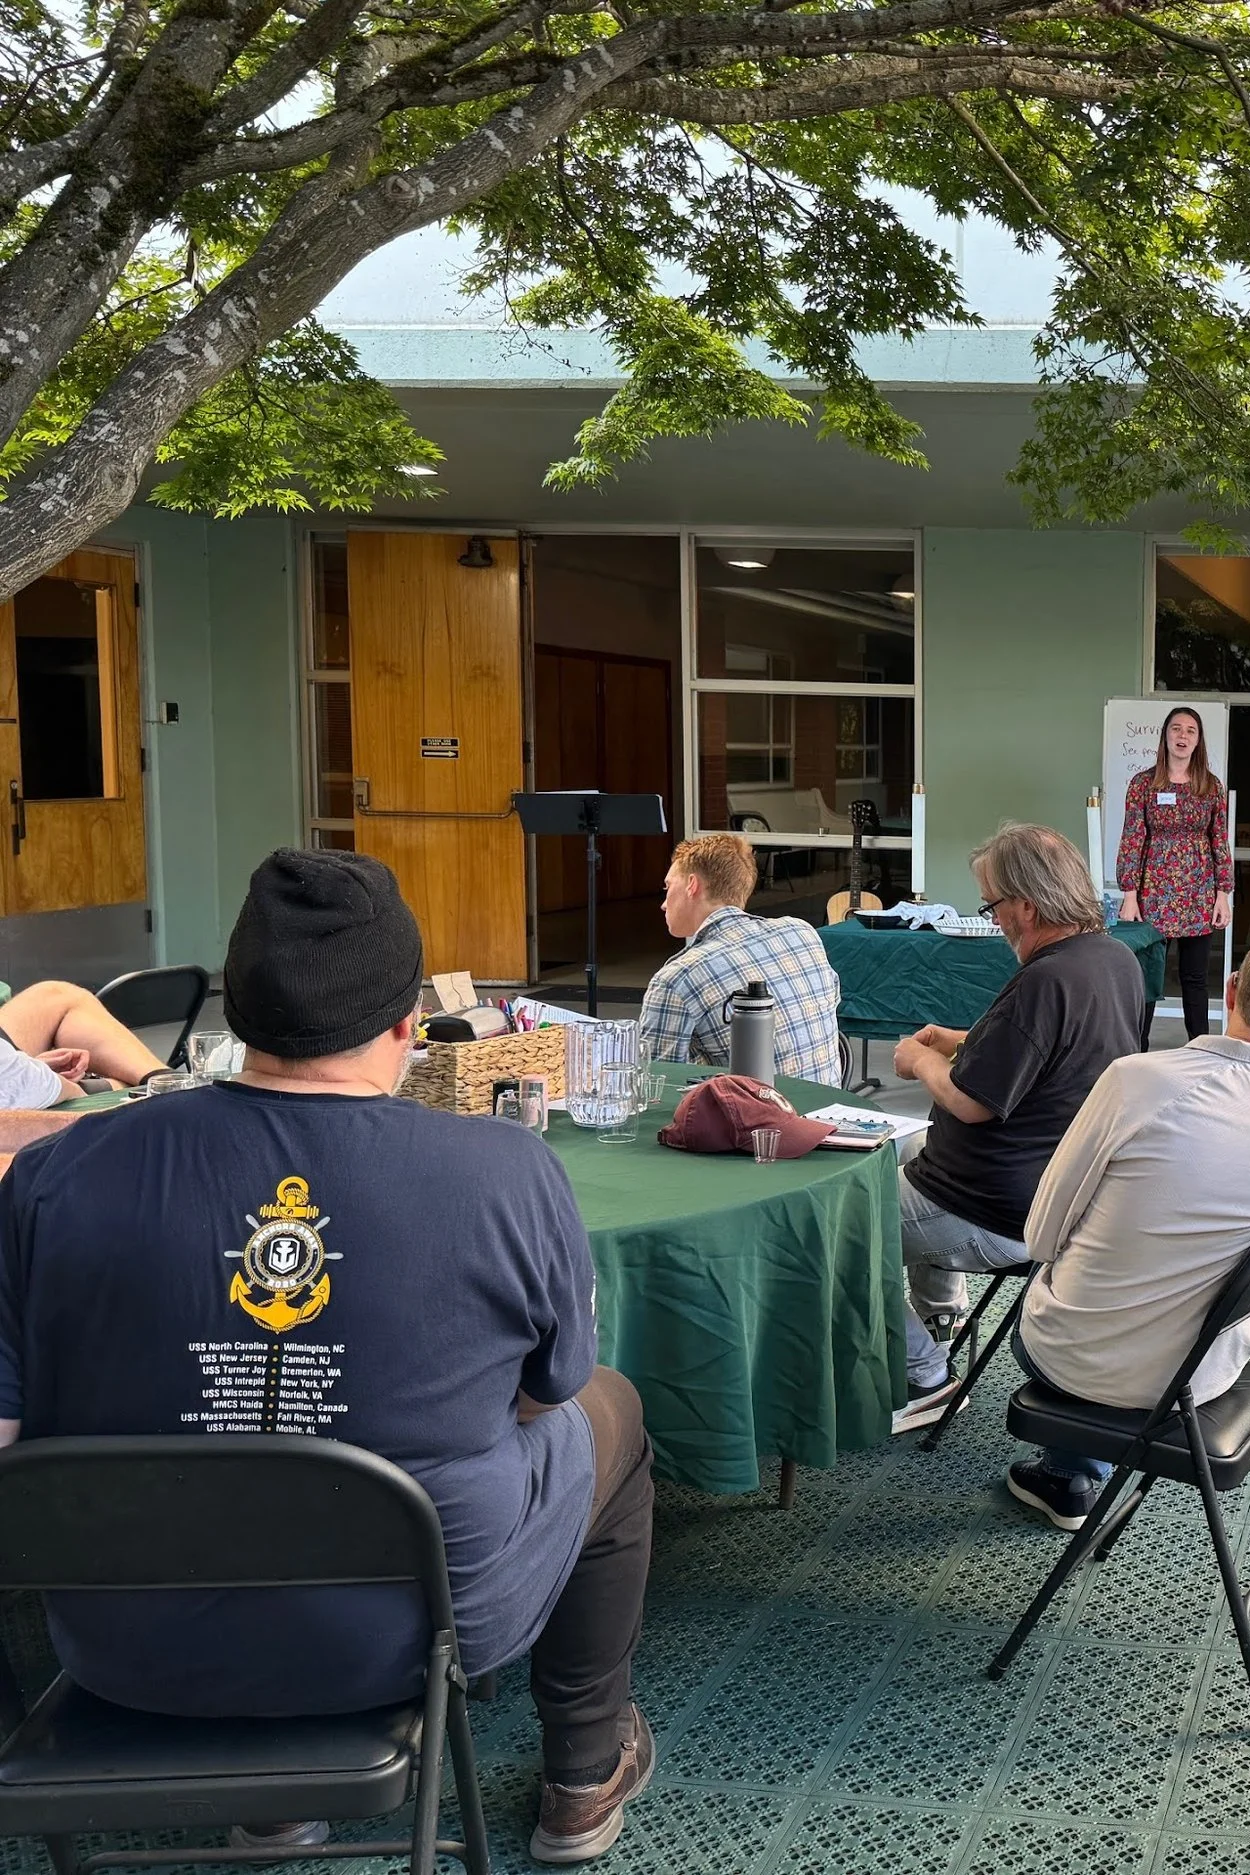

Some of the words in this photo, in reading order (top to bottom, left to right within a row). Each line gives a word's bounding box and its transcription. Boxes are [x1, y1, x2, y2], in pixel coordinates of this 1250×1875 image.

[188, 1343, 206, 1351] USS
[208, 1342, 232, 1351] North
[234, 1342, 269, 1351] Carolina
[283, 1343, 331, 1354] Wilmington,
[332, 1344, 345, 1353] NC
[199, 1354, 217, 1363] USS
[219, 1354, 238, 1362] New
[239, 1354, 268, 1363] Jersey
[282, 1355, 317, 1366] Camden,
[319, 1356, 331, 1365] NJ
[202, 1366, 220, 1375] USS
[223, 1366, 250, 1374] Turner
[251, 1366, 266, 1375] Joy
[282, 1367, 325, 1377] Bremerton,
[327, 1368, 341, 1377] WA
[214, 1377, 232, 1386] USS
[234, 1377, 266, 1387] Intrepid
[280, 1379, 298, 1387] New
[300, 1379, 320, 1389] York,
[322, 1380, 334, 1389] NY
[202, 1389, 220, 1398] USS
[222, 1389, 265, 1398] Wisconsin
[279, 1390, 310, 1400] Norfolk,
[312, 1391, 323, 1400] VA
[212, 1400, 238, 1409] HMCS
[317, 1403, 348, 1412] Canada
[180, 1413, 198, 1421] USS
[200, 1412, 262, 1421] Massachusetts
[277, 1413, 292, 1421] Fall
[294, 1414, 316, 1424] River,
[318, 1415, 332, 1423] MA
[206, 1424, 224, 1432] USS
[226, 1423, 261, 1432] Alabama
[276, 1424, 305, 1434] Mobile,
[306, 1425, 317, 1435] AL
